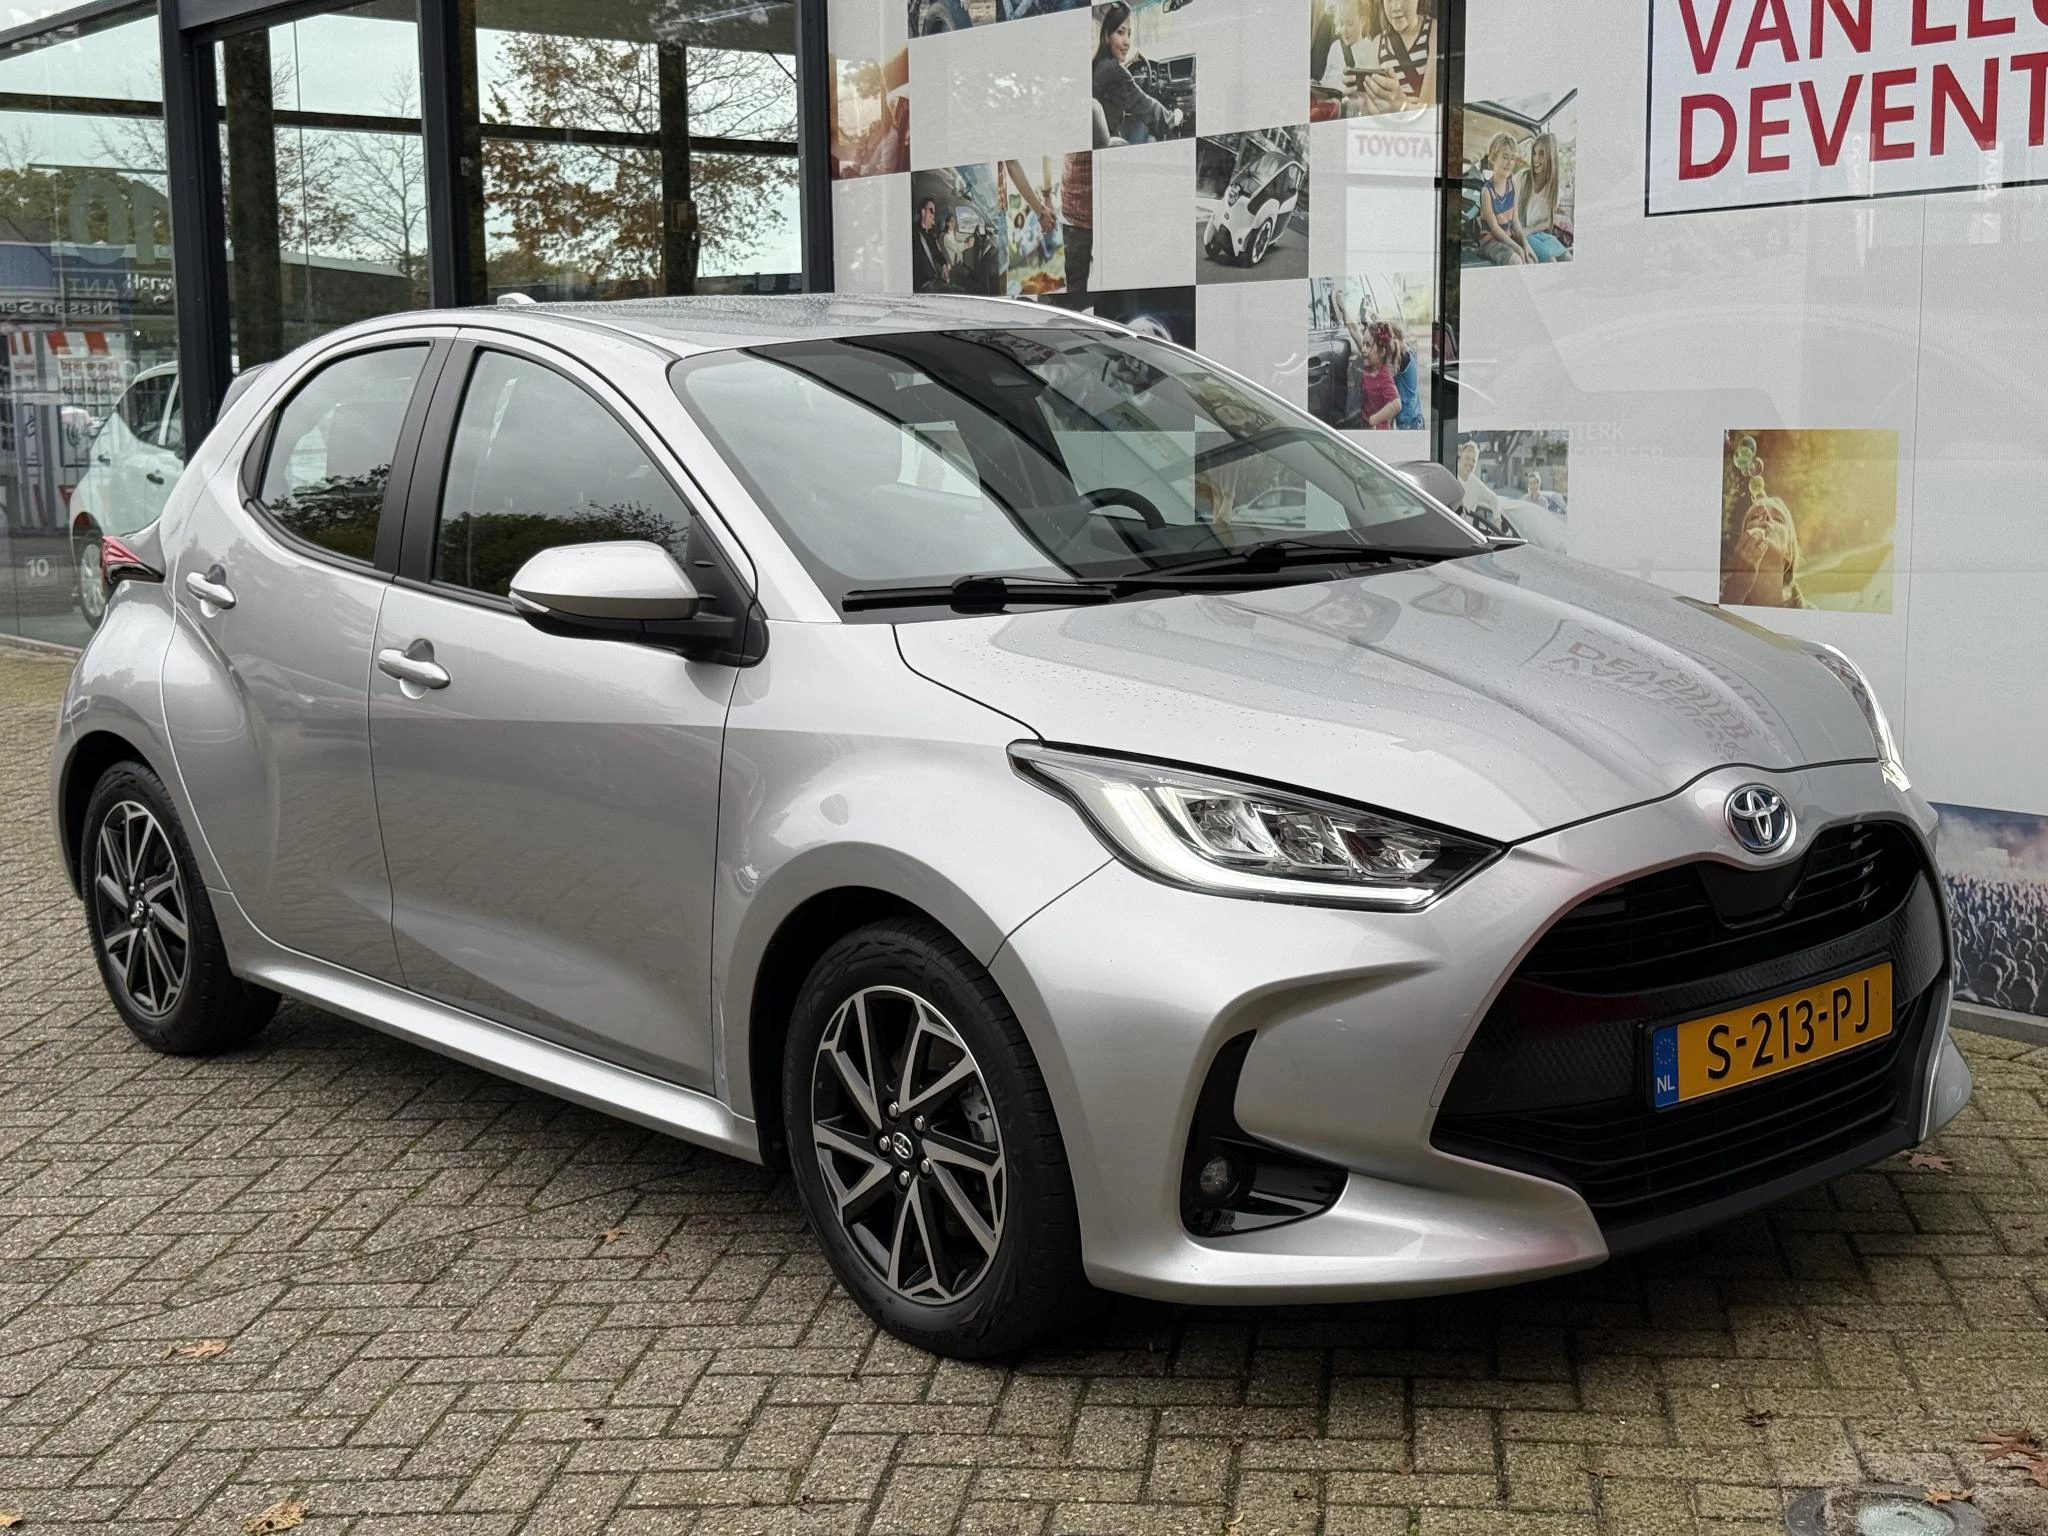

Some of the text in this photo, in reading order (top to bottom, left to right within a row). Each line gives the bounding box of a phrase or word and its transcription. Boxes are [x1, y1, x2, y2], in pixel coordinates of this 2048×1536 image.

[1678, 0, 1872, 75] VAN
[1679, 52, 2048, 181] DEVENT
[1355, 134, 1433, 158] TOYOTA
[27, 559, 49, 578] 10
[1706, 978, 1870, 1080] S-213-PJ
[1656, 1074, 1676, 1094] NL
